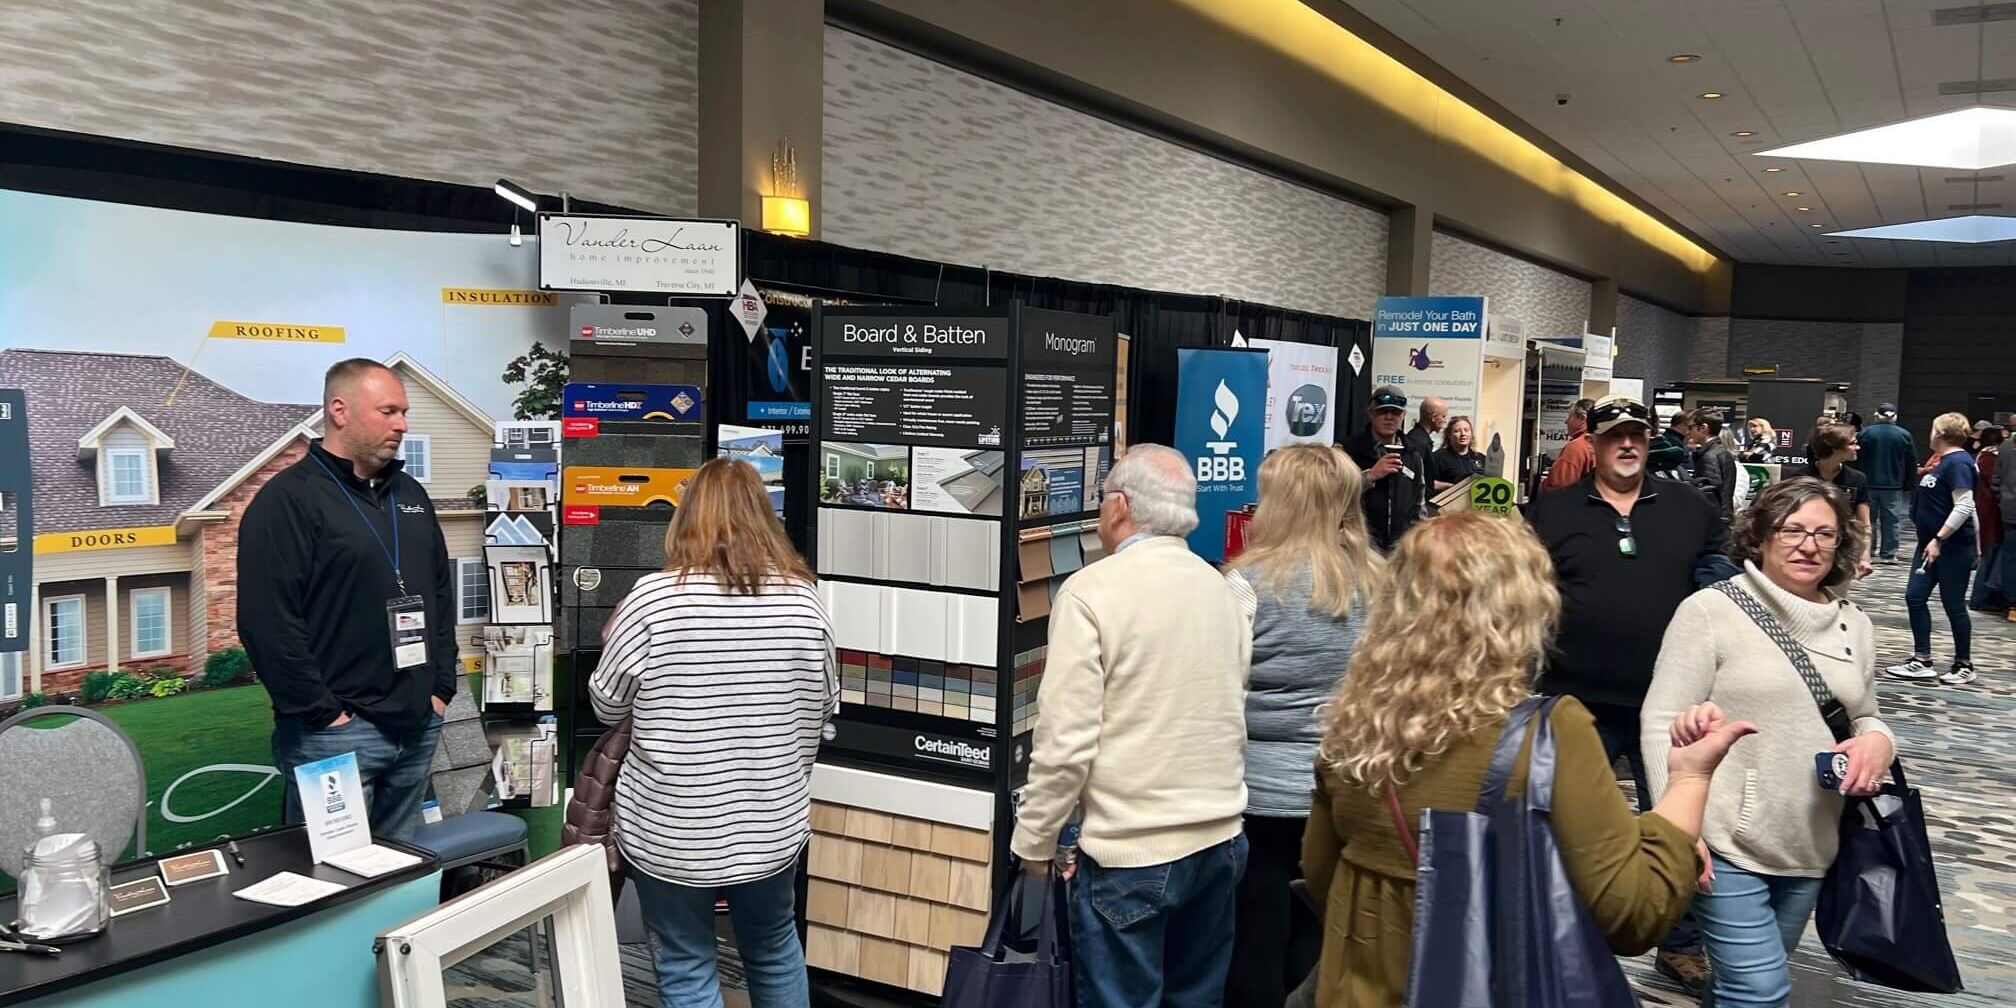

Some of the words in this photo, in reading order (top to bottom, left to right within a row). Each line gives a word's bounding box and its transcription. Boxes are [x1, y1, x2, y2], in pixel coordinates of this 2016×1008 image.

[554, 221, 640, 248] Vander
[641, 227, 722, 252] Laan
[570, 253, 607, 261] home
[617, 254, 715, 266] improvement
[448, 290, 552, 304] INSULATION
[1377, 310, 1423, 320] Remodel
[1424, 310, 1449, 320] Your
[1451, 311, 1476, 321] Bath
[236, 325, 320, 340] ROOFING
[595, 326, 636, 336] Timberline
[637, 328, 656, 337] UHD
[843, 323, 897, 342] Board
[903, 324, 917, 343] &
[924, 325, 986, 344] Batten
[1377, 323, 1387, 331] in
[1388, 323, 1419, 331] JUST
[1423, 323, 1449, 331] ONE
[1452, 323, 1478, 332] DAY
[1045, 331, 1095, 355] Monogram
[1376, 375, 1405, 384] FREE
[586, 400, 625, 409] Timberline
[1197, 457, 1246, 481] BBB
[587, 483, 626, 492] Timberline
[1474, 482, 1511, 505] 20
[71, 531, 137, 548] DOORS
[914, 735, 990, 760] CertainTeed
